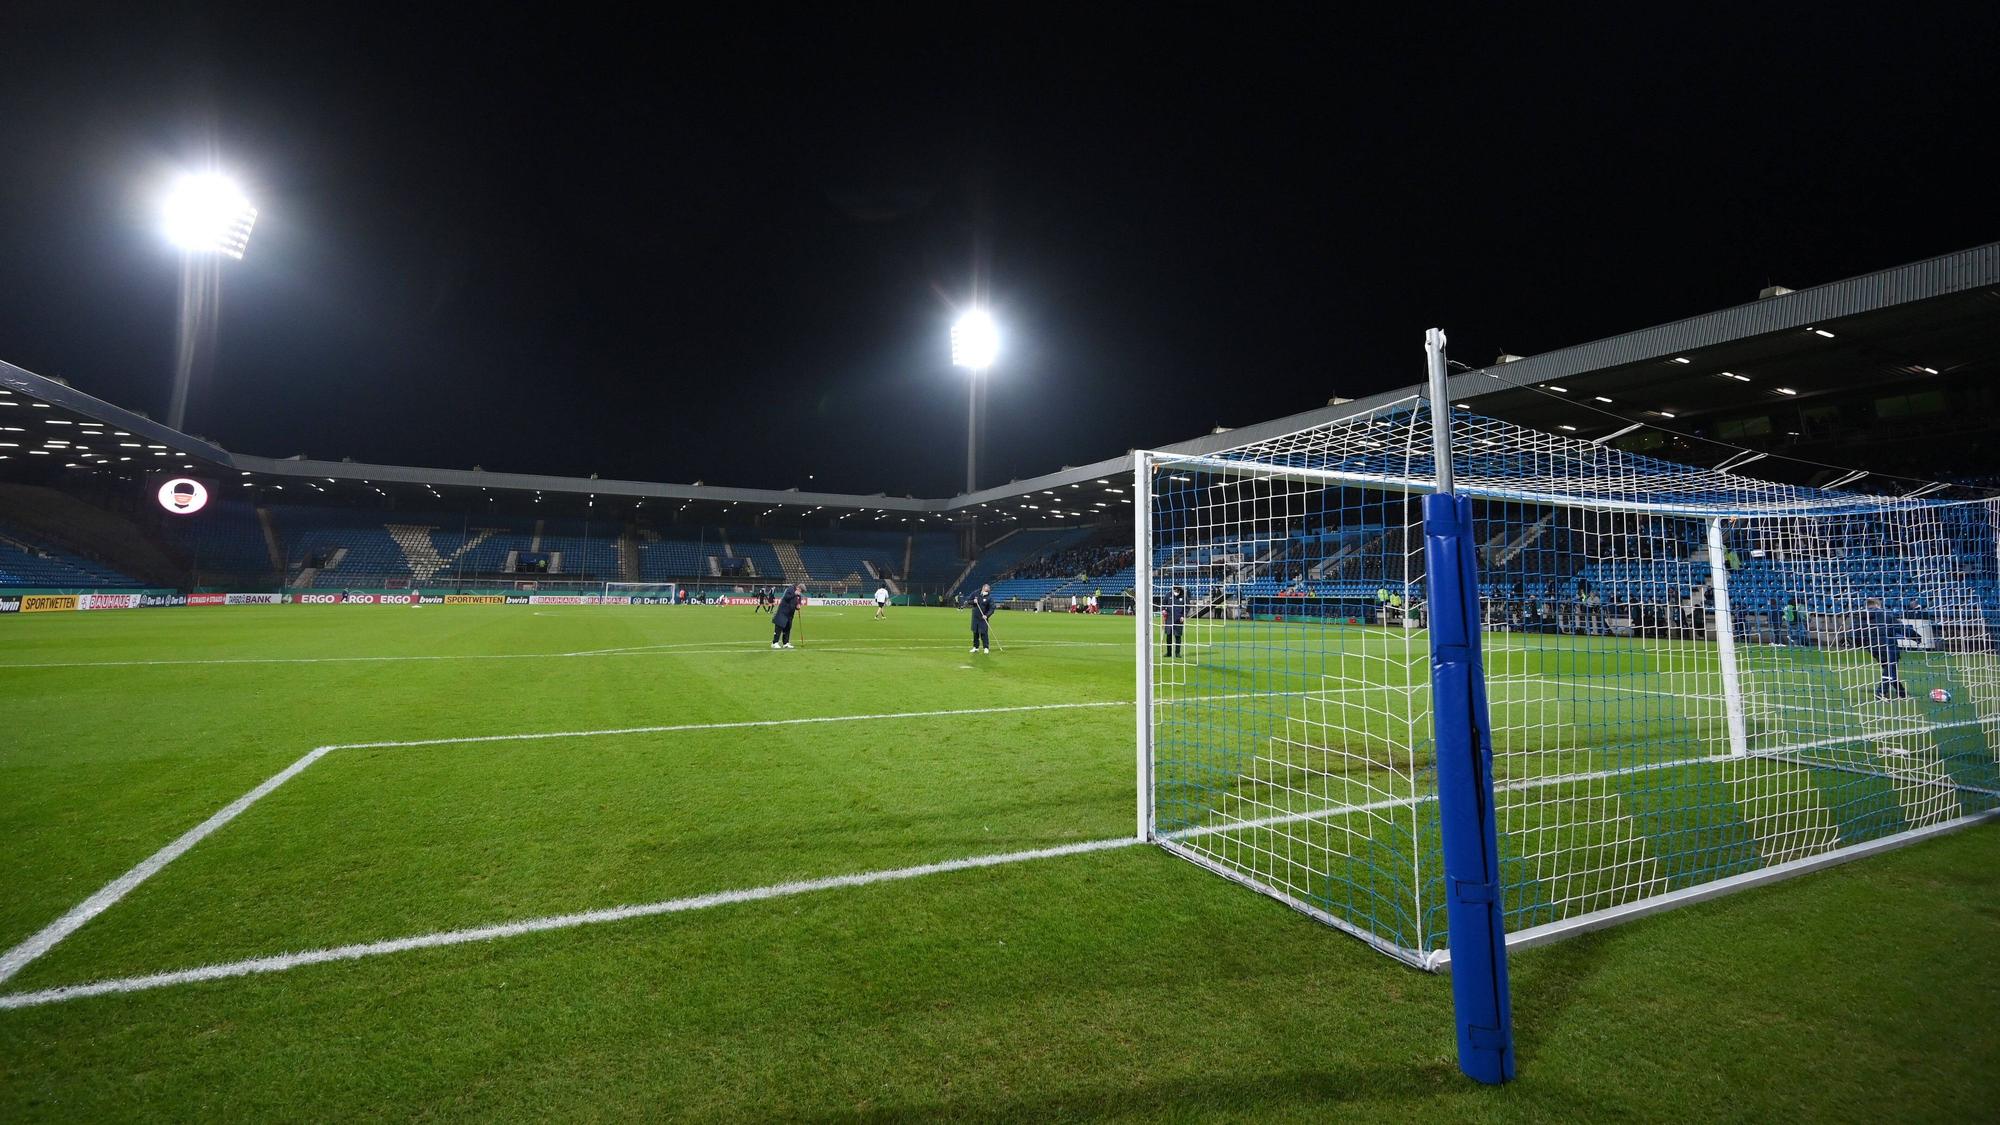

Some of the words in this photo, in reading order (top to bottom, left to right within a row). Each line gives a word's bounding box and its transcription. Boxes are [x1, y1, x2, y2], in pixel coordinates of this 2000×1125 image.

[25, 597, 76, 610] SPORTWETTEN
[90, 595, 130, 608] BAUHAUS
[301, 594, 335, 604] ERGO
[380, 595, 411, 605] ERGO
[419, 596, 443, 604] bwin
[447, 596, 503, 604] SPORTWETTEN
[538, 596, 581, 604] BAUHAUS
[644, 597, 658, 605] Der
